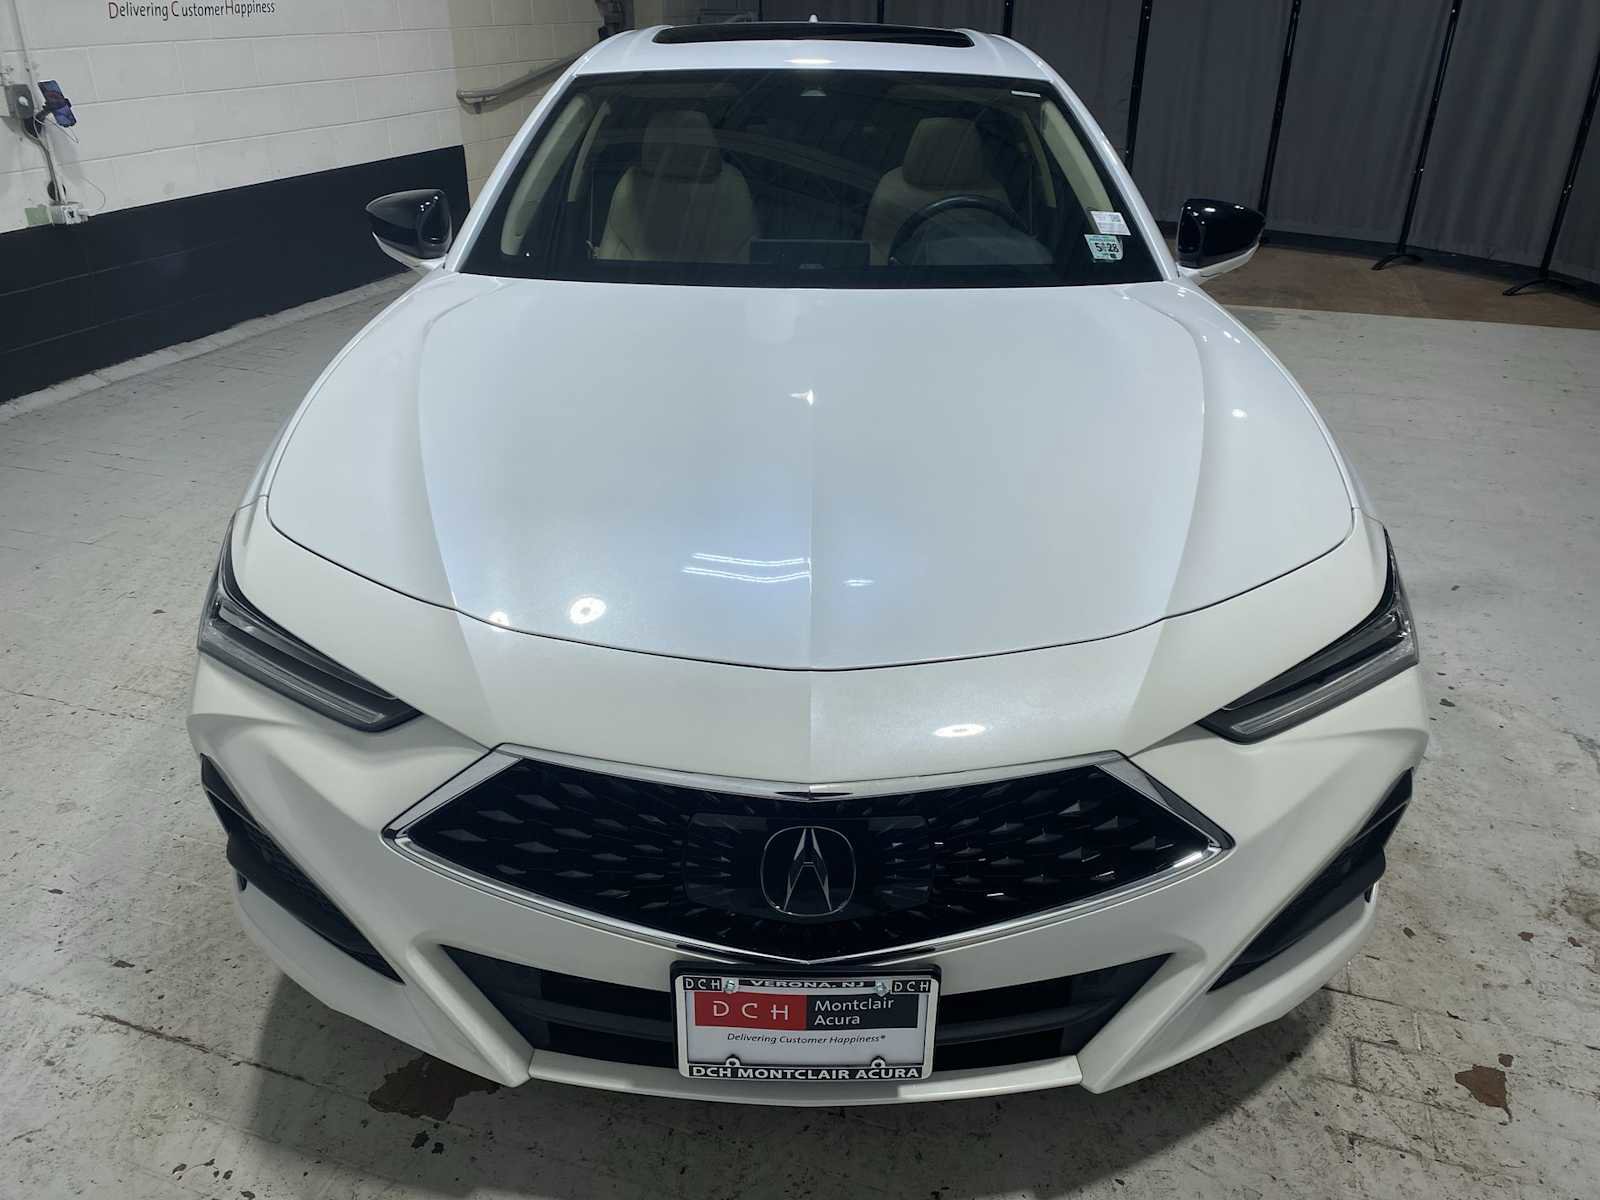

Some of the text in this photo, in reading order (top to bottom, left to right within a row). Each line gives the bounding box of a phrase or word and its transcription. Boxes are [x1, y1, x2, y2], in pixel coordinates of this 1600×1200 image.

[108, 2, 169, 21] Delivering
[225, 0, 275, 18] Happiness
[815, 997, 895, 1012] Montclair
[814, 1014, 861, 1026] Acura
[727, 1033, 777, 1045] Delivering
[779, 1036, 827, 1045] Customer
[693, 1067, 920, 1079] DCH MONTCLAIR ACURA
